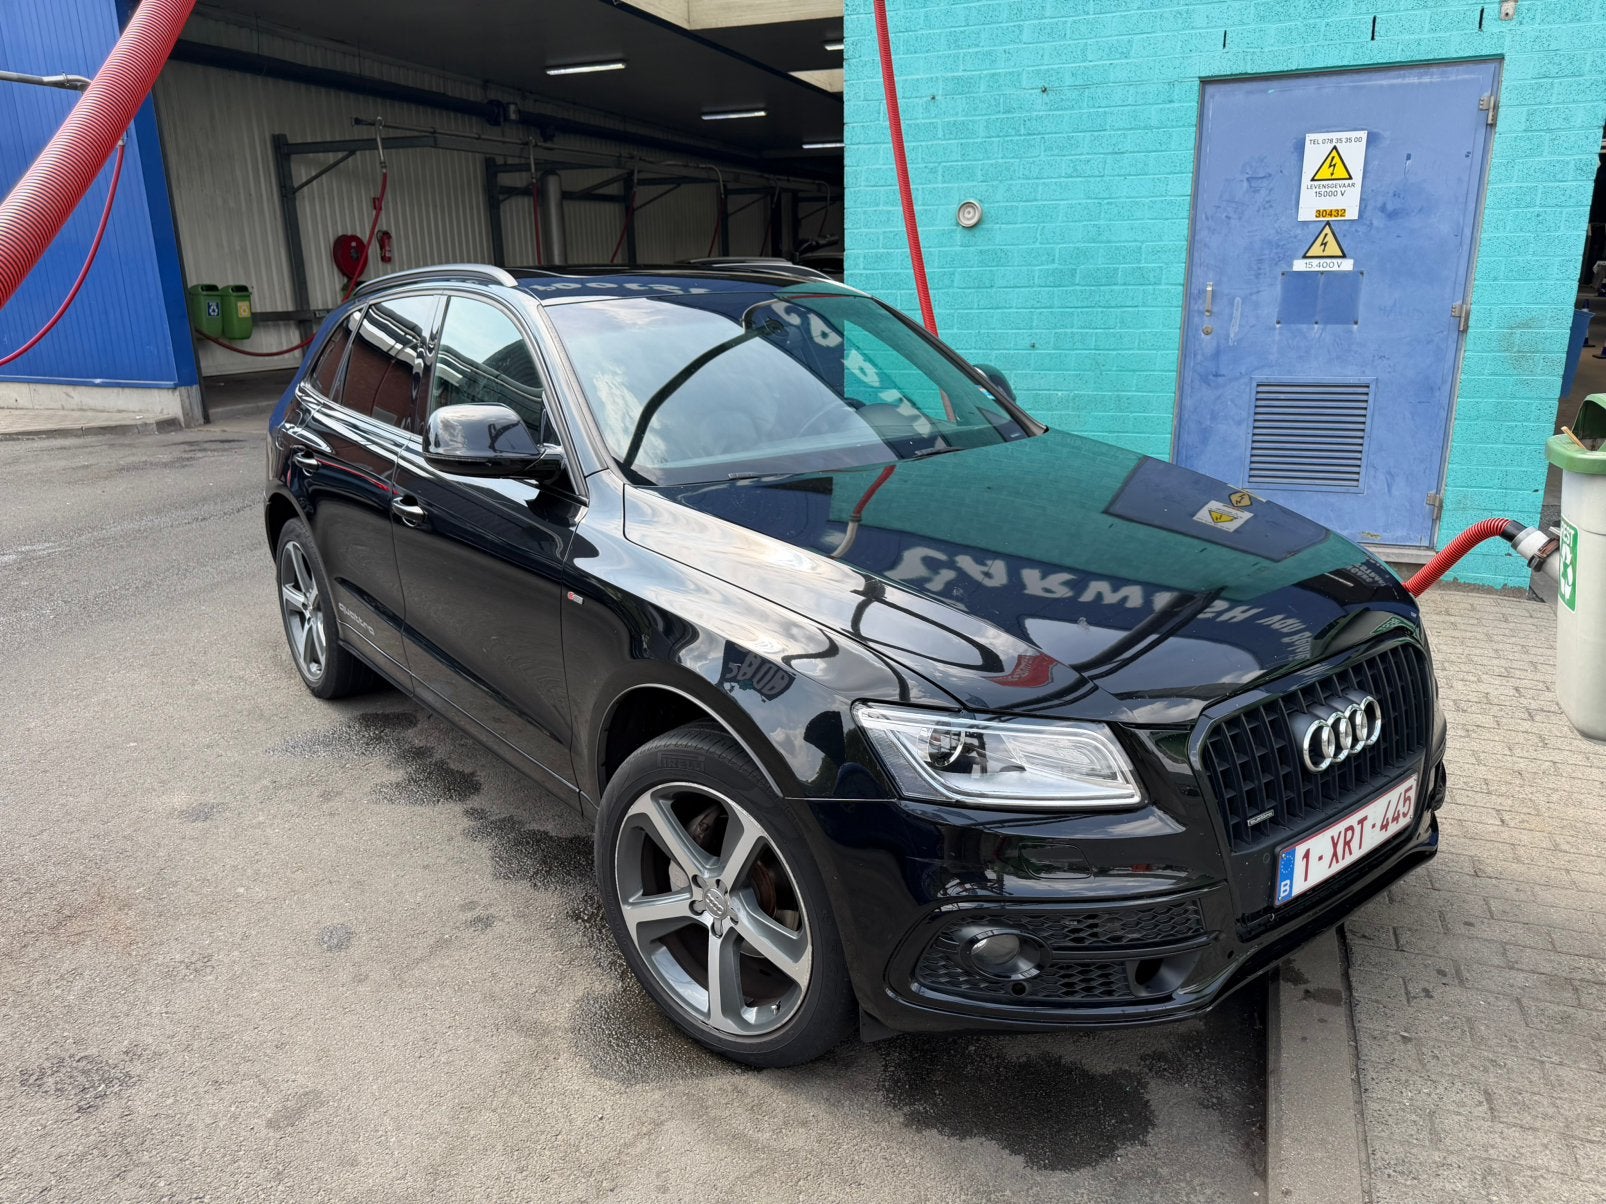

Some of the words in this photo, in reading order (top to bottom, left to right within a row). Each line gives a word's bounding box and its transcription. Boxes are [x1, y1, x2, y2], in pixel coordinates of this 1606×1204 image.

[1306, 182, 1356, 190] LEVENSGEVAAR
[1314, 190, 1338, 198] 15000
[1315, 209, 1347, 218] 30432
[1304, 261, 1335, 269] 15.400
[1336, 261, 1343, 269] V
[1301, 784, 1413, 882] 1-XRT-445
[1279, 880, 1291, 898] B
